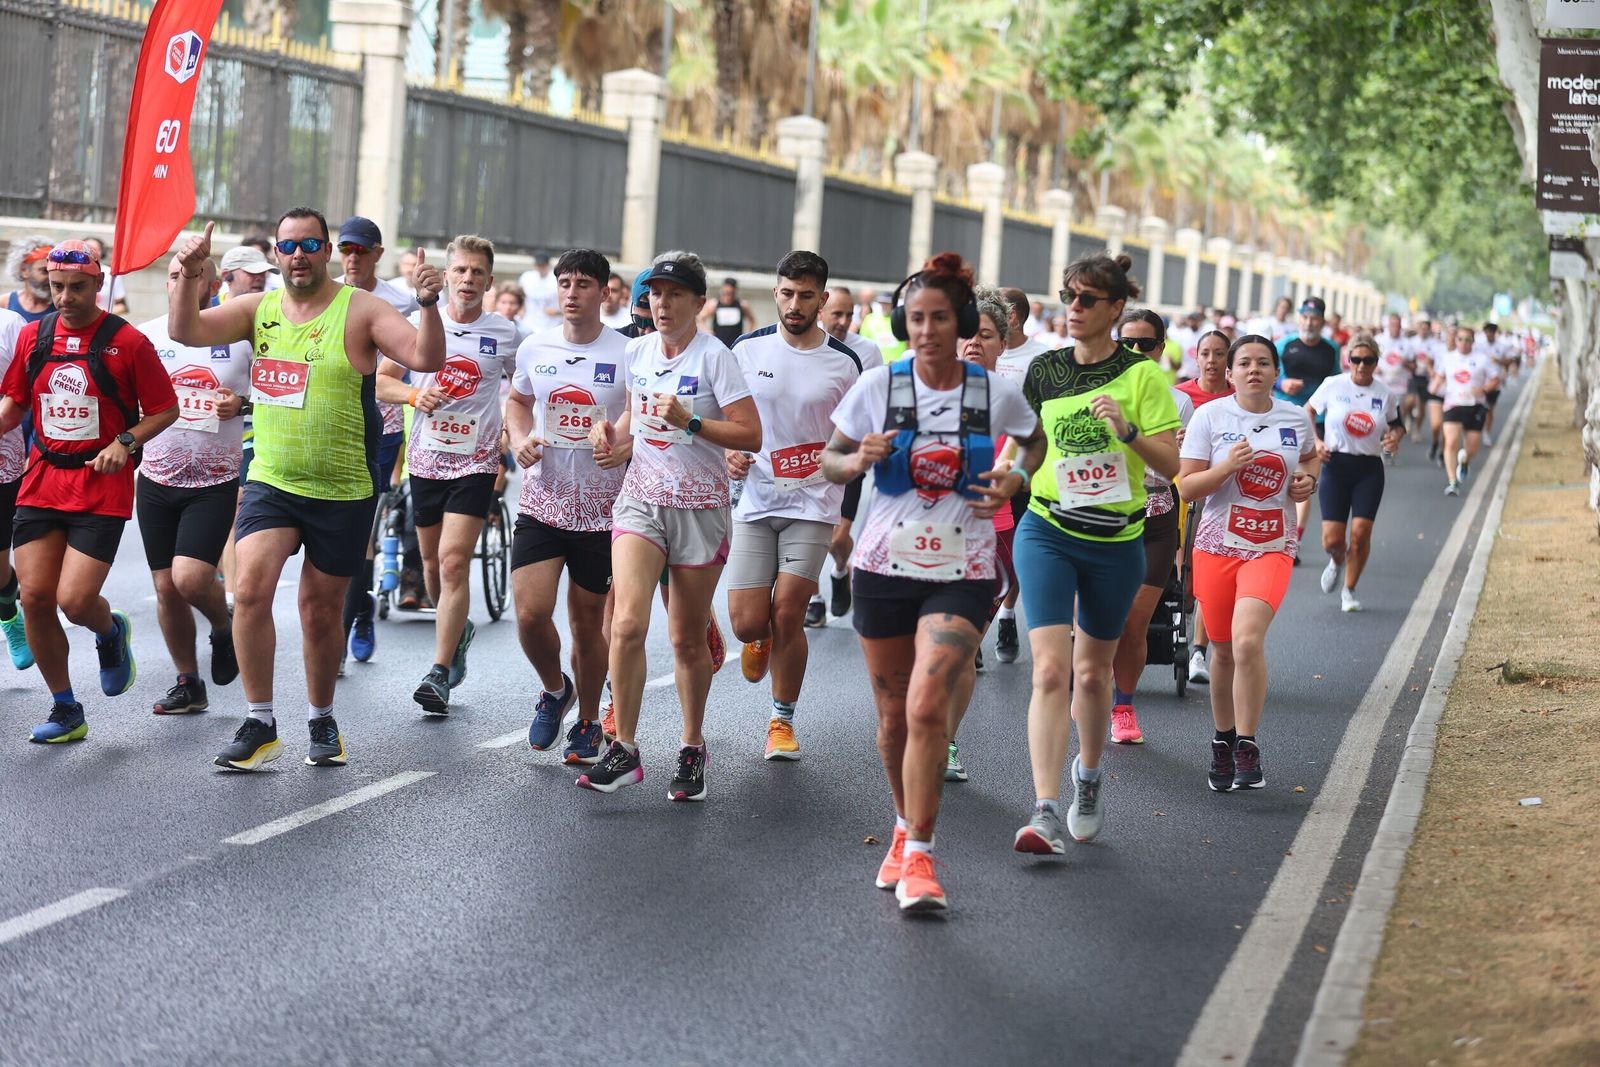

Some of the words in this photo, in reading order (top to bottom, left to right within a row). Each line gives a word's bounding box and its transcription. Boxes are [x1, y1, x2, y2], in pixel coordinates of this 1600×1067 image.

[156, 120, 181, 153] 60
[211, 349, 228, 358] AXA
[480, 345, 494, 353] AXA
[57, 372, 82, 387] PONLE
[257, 369, 299, 385] 2160
[594, 373, 612, 382] AXA
[758, 370, 774, 379] FILA
[54, 381, 80, 395] FRENO
[176, 377, 213, 389] PONLE
[48, 406, 89, 418] 1375
[431, 420, 470, 435] 1268
[559, 415, 592, 428] 268
[1281, 437, 1296, 446] AXA
[1067, 465, 1117, 484] 1002
[1246, 464, 1282, 480] PONLE
[1242, 472, 1277, 489] FRENO
[1235, 516, 1278, 532] 2347
[914, 536, 942, 551] 36
